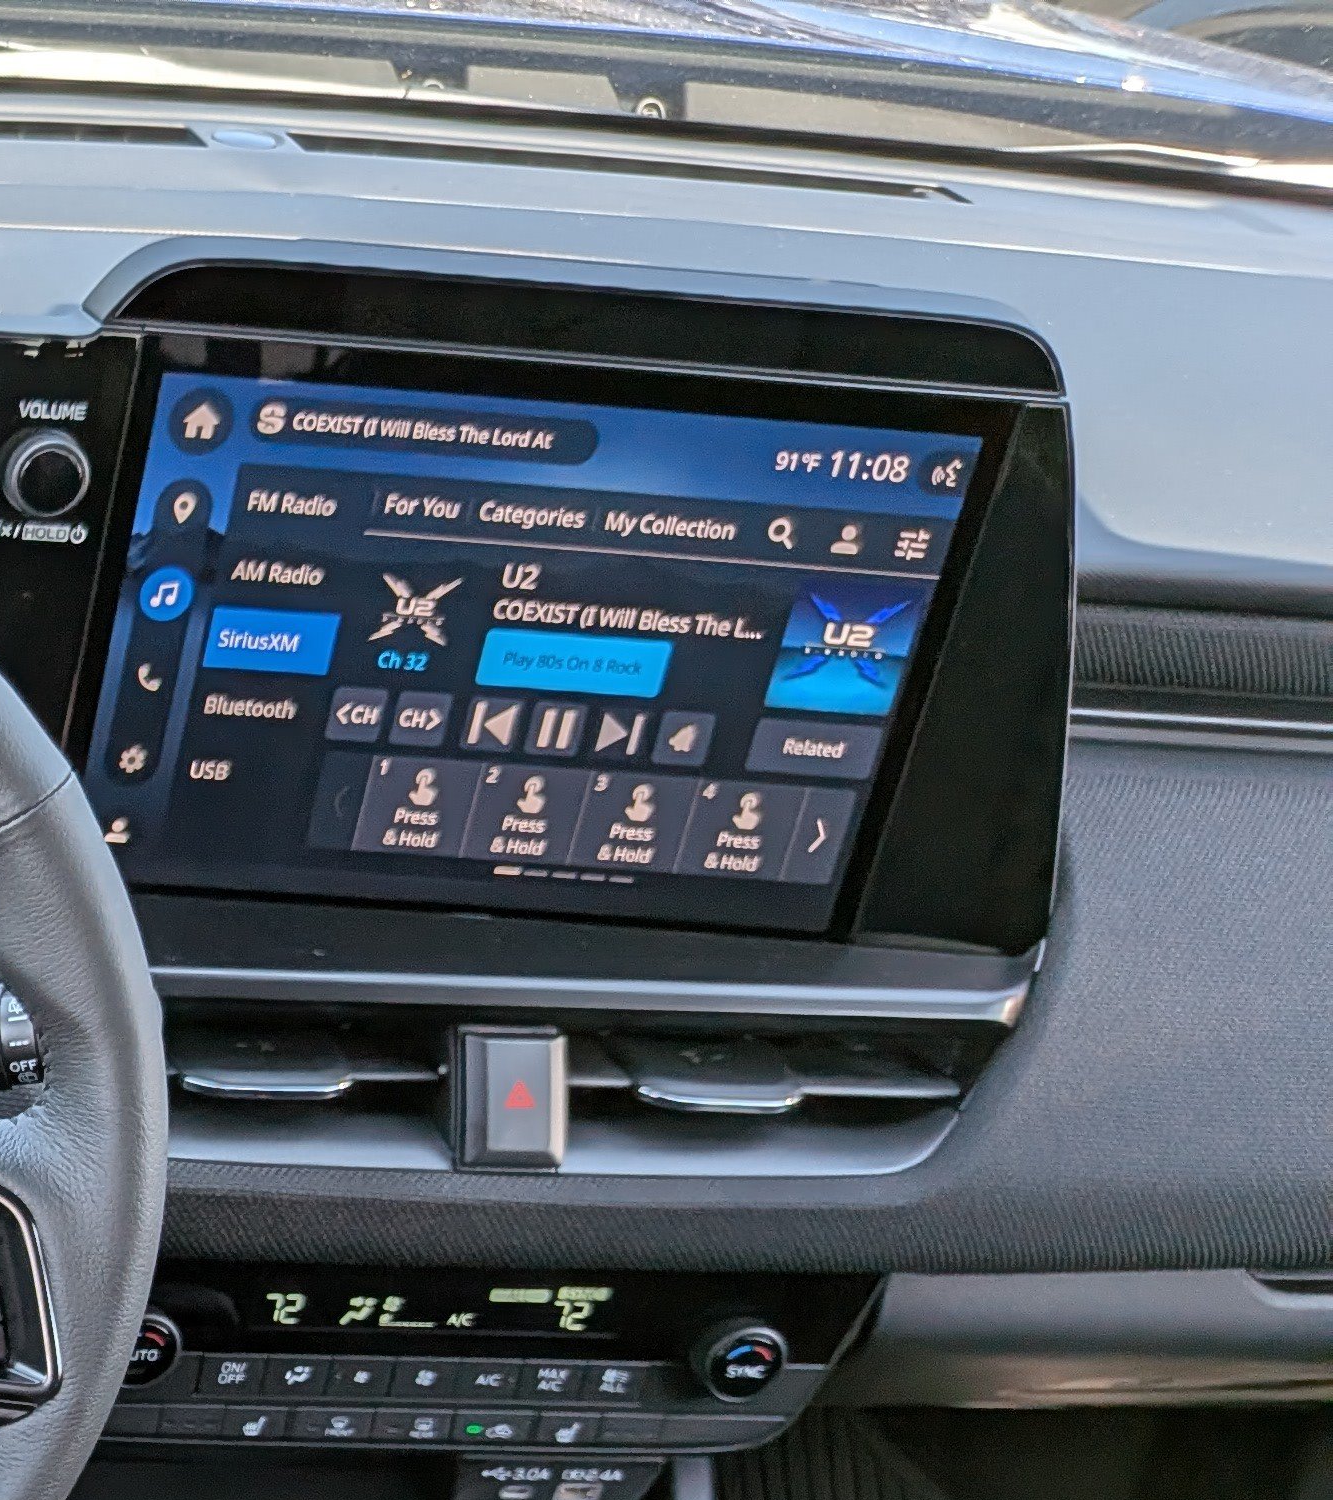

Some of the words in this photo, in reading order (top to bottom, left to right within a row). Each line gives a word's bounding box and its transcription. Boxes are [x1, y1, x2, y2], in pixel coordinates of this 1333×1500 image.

[19, 399, 89, 421] VOLUME
[293, 411, 362, 436] COEXIST
[381, 418, 410, 440] Will
[412, 421, 456, 443] Bless
[459, 424, 490, 446] The
[492, 427, 530, 448] Lord
[532, 431, 553, 450] At
[831, 450, 911, 483] 11:08
[247, 490, 280, 512] FM
[281, 492, 337, 517] Radio
[384, 493, 419, 516] For
[423, 496, 461, 519] You
[479, 500, 586, 530] Categories
[605, 511, 637, 537] My
[639, 514, 736, 540] Collection
[23, 525, 68, 542] HOLD
[231, 559, 267, 582] AM
[269, 562, 325, 586] Radio
[502, 562, 542, 590] U2
[396, 597, 436, 616] U2
[493, 598, 581, 624] COEXIST
[580, 604, 598, 629] (I
[599, 606, 637, 630] Will
[638, 609, 693, 634] Bless
[694, 613, 732, 637] The
[218, 629, 300, 652] SiriusXM
[823, 622, 875, 647] U2
[378, 651, 403, 669] Ch
[403, 653, 431, 672] 32
[502, 650, 534, 671] Play
[566, 655, 589, 672] On
[605, 659, 642, 676] Rock
[203, 694, 297, 719] Bluetooth
[782, 737, 847, 759] Related
[190, 759, 232, 780] USB
[380, 757, 391, 776] 1
[486, 765, 501, 784] 2
[593, 773, 610, 792] 3
[702, 782, 719, 800] 4
[394, 807, 439, 825] Press
[501, 815, 548, 833] Press
[382, 829, 396, 846] &
[399, 830, 440, 848] Hold
[609, 822, 655, 841] Press
[716, 830, 762, 849] Press
[490, 836, 505, 854] &
[506, 837, 548, 856] Hold
[597, 844, 613, 861] &
[613, 845, 654, 864] Hold
[704, 852, 719, 870] &
[720, 853, 762, 872] Hold
[9, 1058, 38, 1073] OFF
[266, 1293, 307, 1324] 72
[554, 1300, 594, 1331] 72
[446, 1312, 477, 1328] A/C
[218, 1373, 246, 1385] OFF
